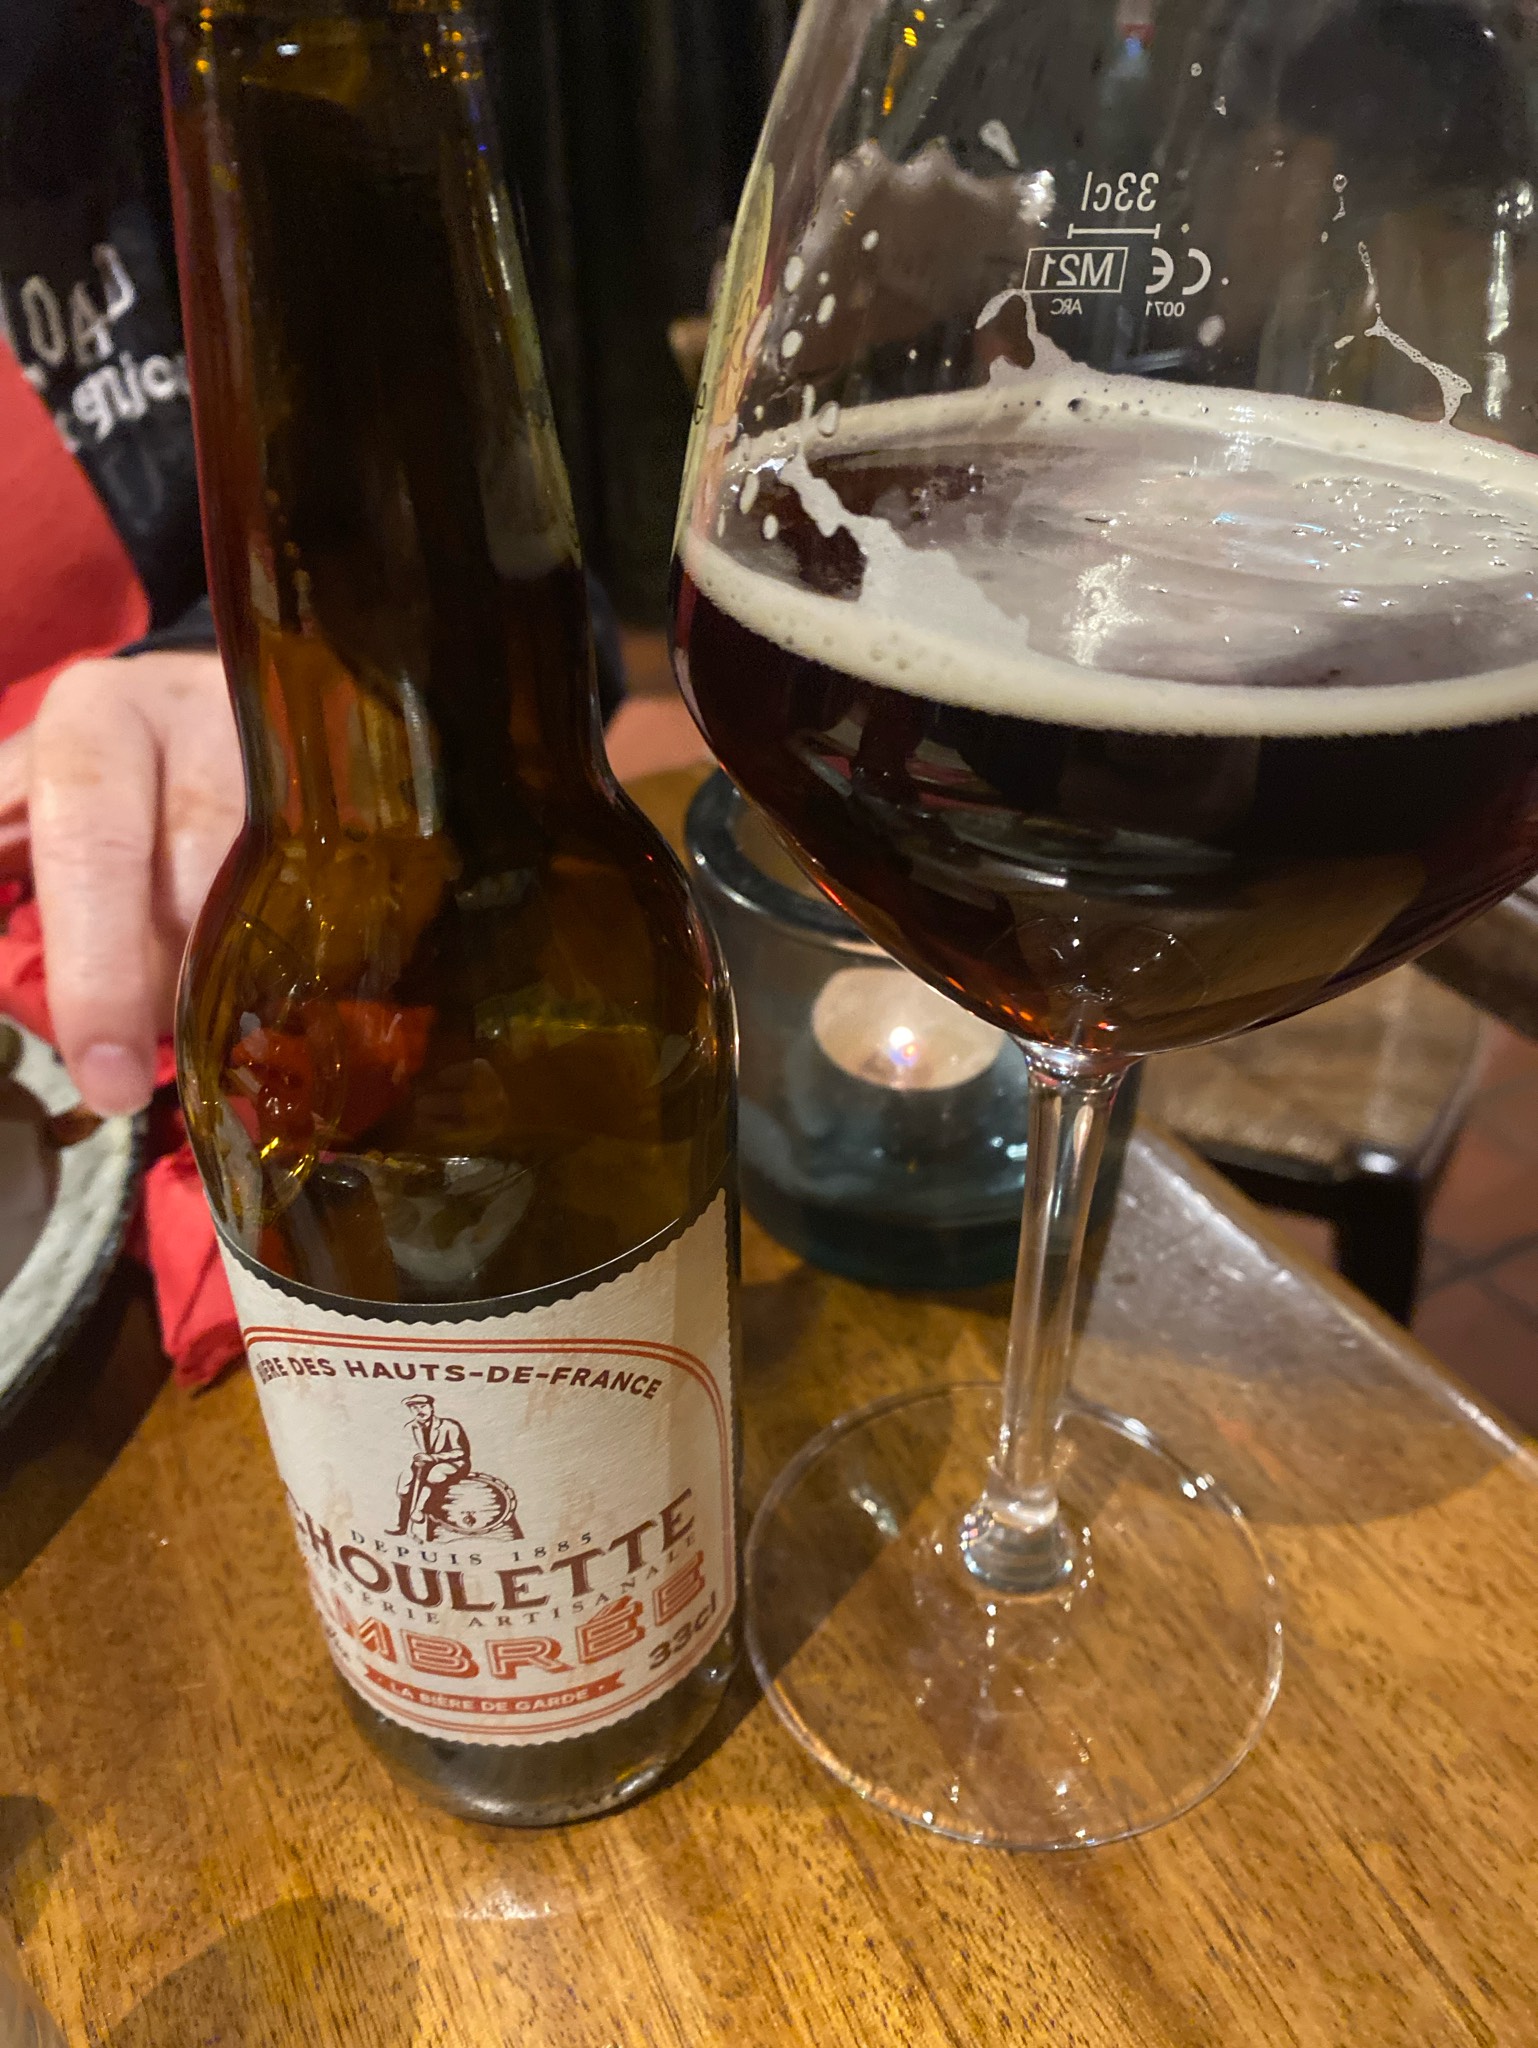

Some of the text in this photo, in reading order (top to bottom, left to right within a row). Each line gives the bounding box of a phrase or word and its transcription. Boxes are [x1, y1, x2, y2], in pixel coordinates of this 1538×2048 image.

[287, 1356, 337, 1378] DES
[344, 1359, 663, 1400] HAUTS-DE-FRANCE
[351, 1529, 592, 1565] DEPUIS 1885
[468, 1534, 696, 1628] ARTISANALE
[648, 1590, 717, 1670] 33cl
[389, 1682, 411, 1698] LA
[480, 1700, 509, 1713] DE
[514, 1687, 589, 1712] GARDE
